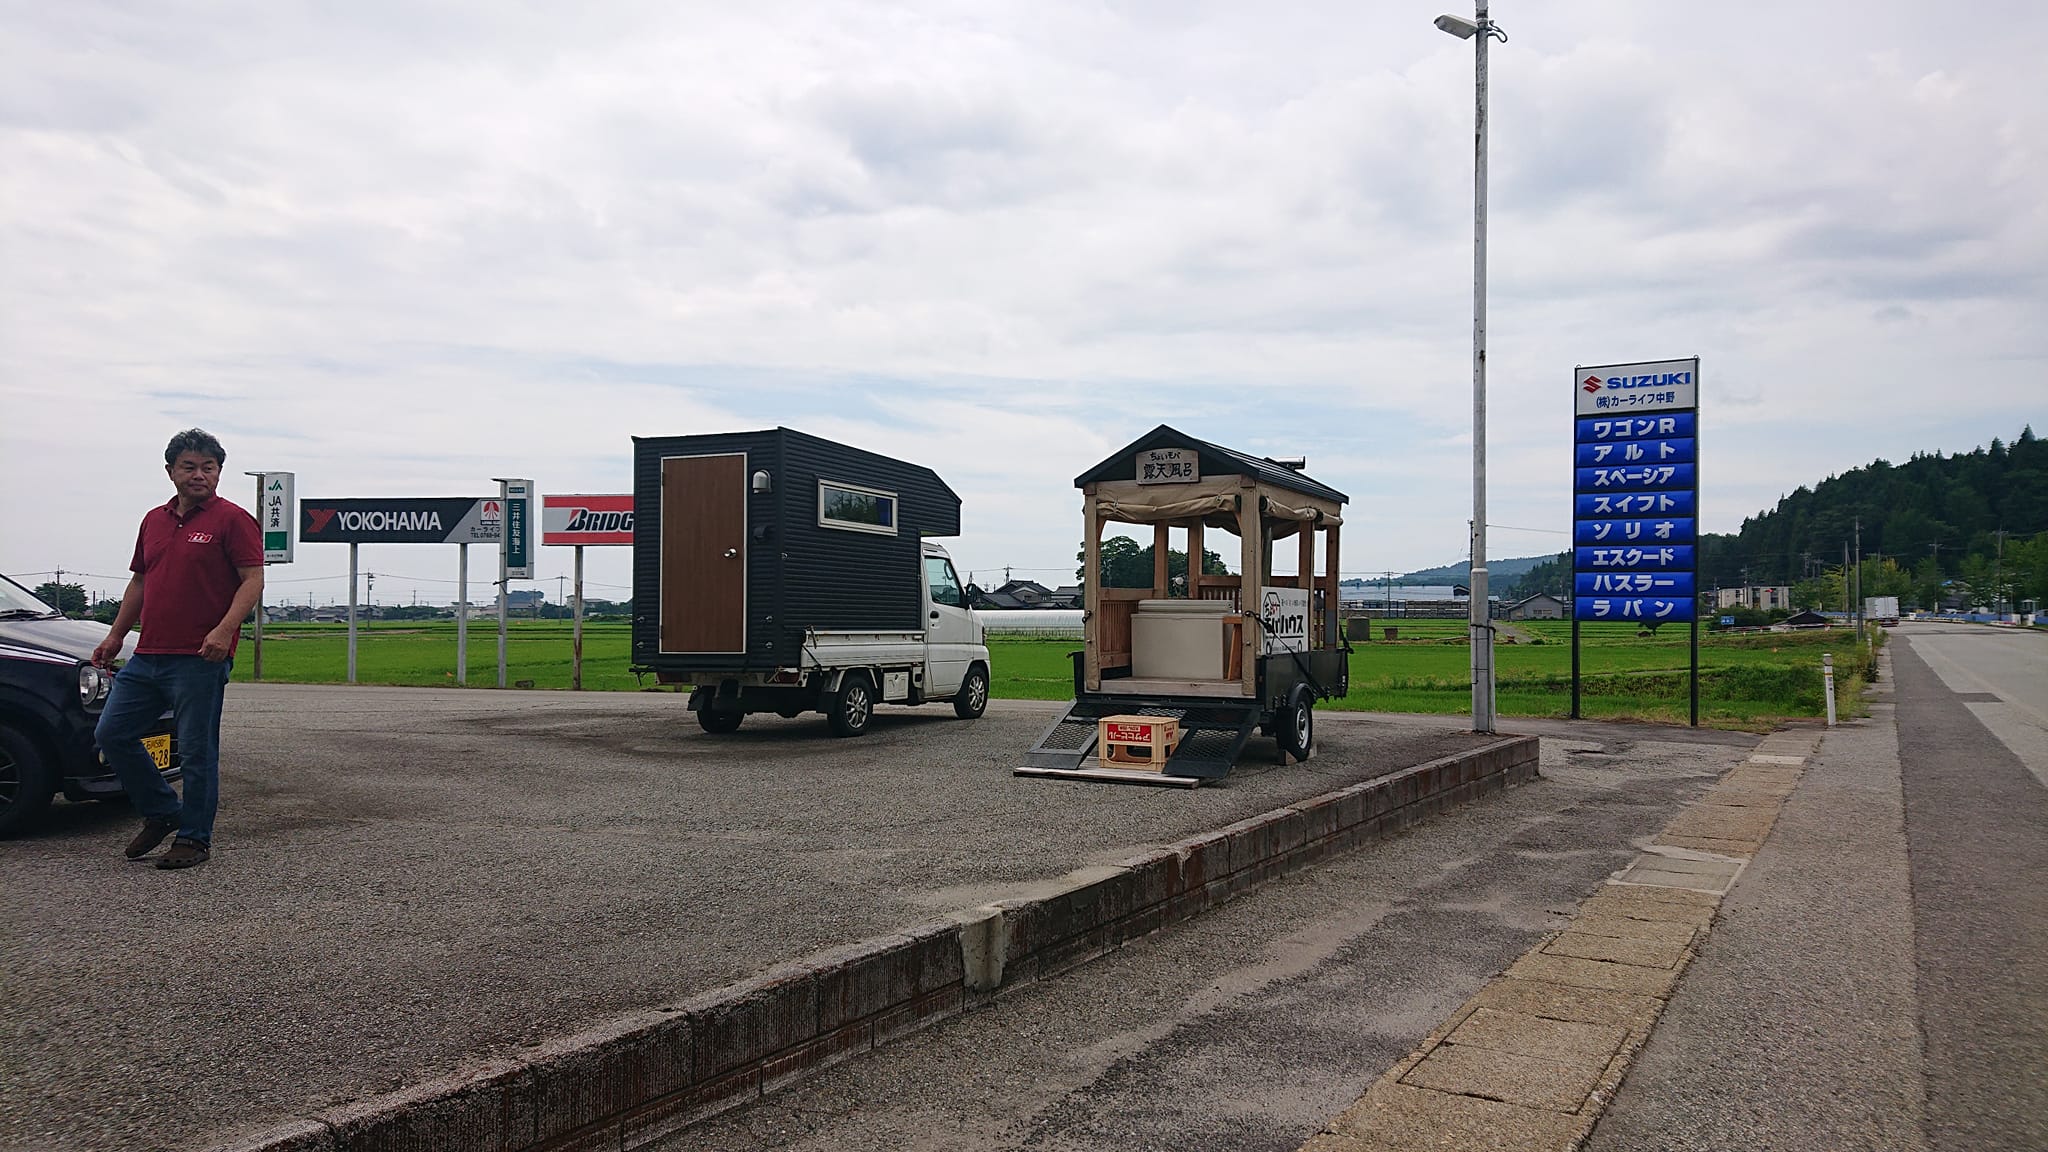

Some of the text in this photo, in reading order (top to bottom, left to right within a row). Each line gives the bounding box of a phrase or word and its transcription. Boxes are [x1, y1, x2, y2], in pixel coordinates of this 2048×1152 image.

[1606, 371, 1691, 390] SUZUKI
[1596, 391, 1675, 409] (株)カーライフ中野
[1594, 417, 1676, 439] ワゴンR
[1594, 442, 1676, 462] アルト
[1594, 466, 1676, 487] スペーシア
[1594, 494, 1676, 514] スイフト
[337, 511, 442, 531] YOKOHAMA
[1592, 521, 1675, 541] ソリオ
[1592, 548, 1675, 567] エスクード
[1592, 574, 1675, 593] ハスラー
[1592, 599, 1675, 618] ラパン
[1108, 731, 1150, 742] アサヒビール
